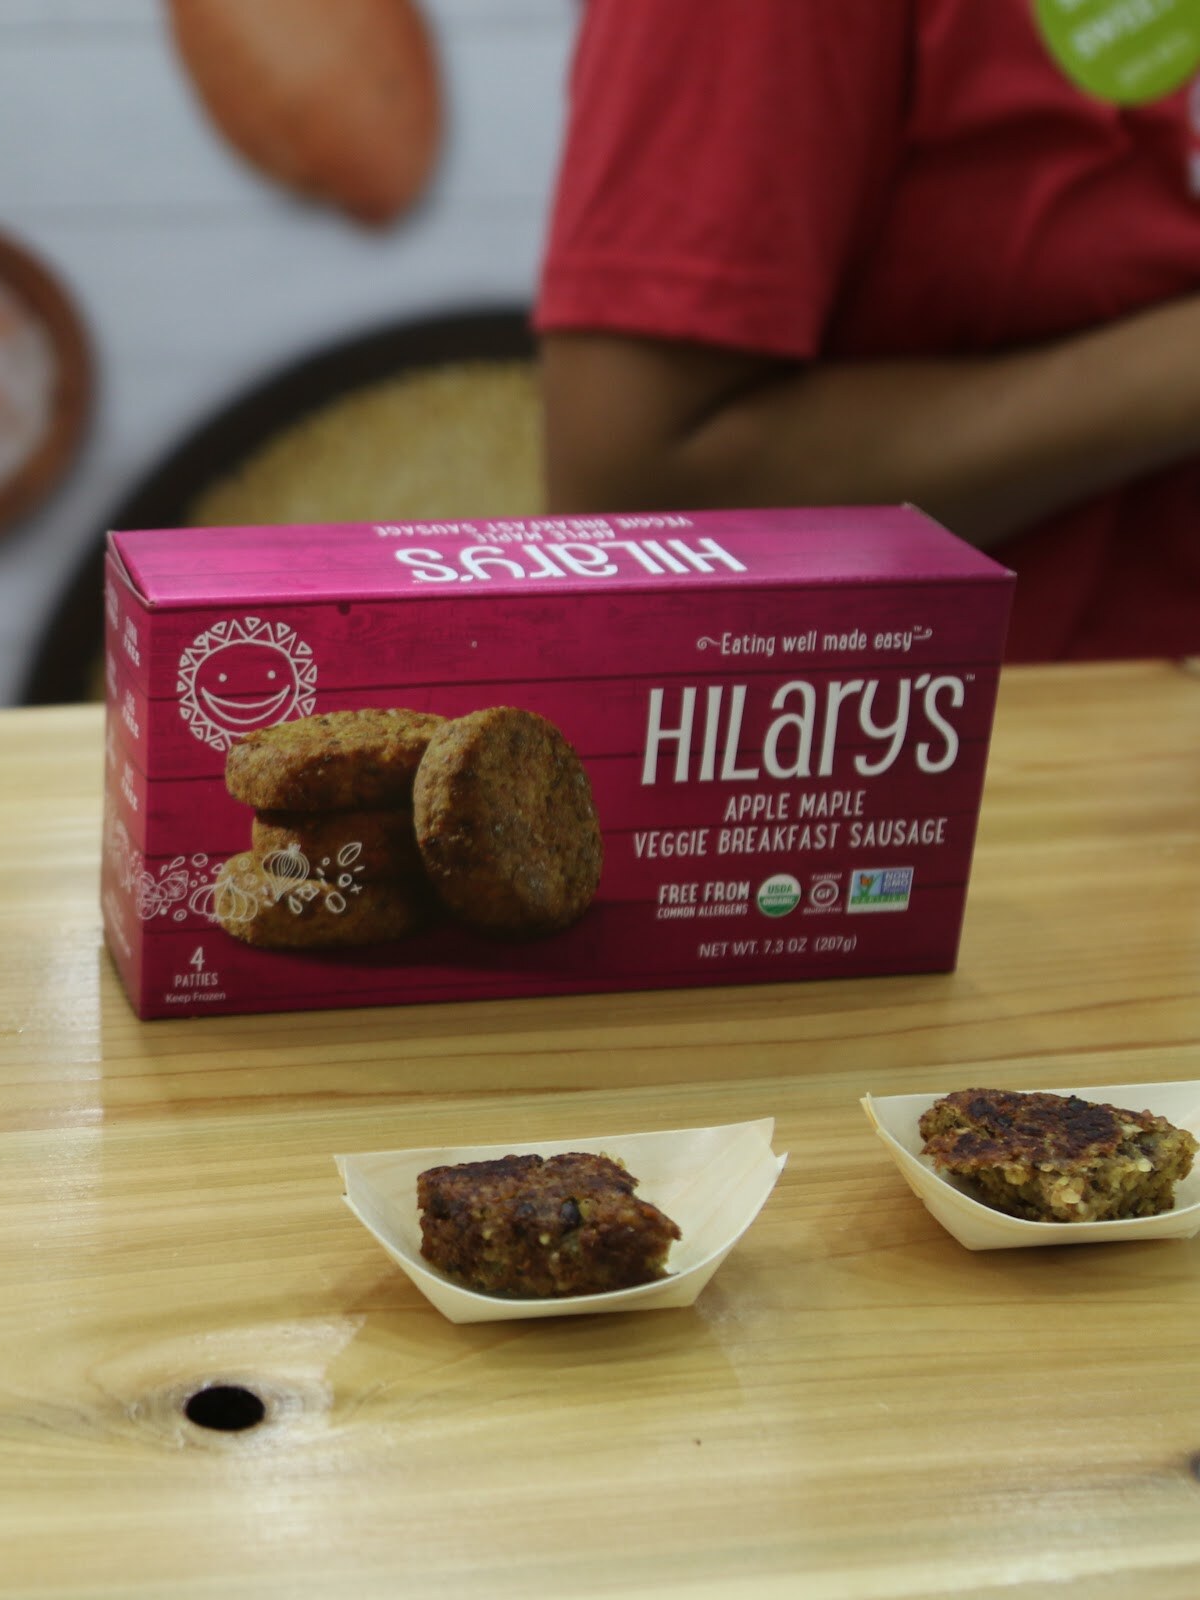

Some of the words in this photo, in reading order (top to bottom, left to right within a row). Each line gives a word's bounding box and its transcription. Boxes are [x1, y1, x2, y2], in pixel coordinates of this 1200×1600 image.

[720, 633, 775, 657] Eating
[782, 631, 816, 652] well
[823, 629, 867, 651] made
[874, 631, 913, 651] easy
[724, 793, 789, 822] APPLE
[799, 791, 866, 818] MAPLE
[634, 831, 708, 859] VEGGIE
[718, 824, 840, 853] BREAKFAST
[849, 819, 947, 848] SAUSAGE
[658, 884, 698, 904] FREE
[704, 881, 750, 902] FROM
[767, 884, 793, 894] USDA
[817, 889, 832, 899] GF
[657, 906, 695, 919] COMMON
[698, 904, 748, 917] ALLERGENS
[698, 943, 727, 958] NET
[733, 942, 757, 956] WT.
[763, 940, 783, 954] 7.3
[788, 938, 807, 952] OZ
[816, 936, 857, 953] (207g)
[190, 947, 205, 972] 4
[174, 973, 219, 987] PATTIES
[166, 993, 191, 1004] Keep
[192, 992, 226, 1002] Frozen
